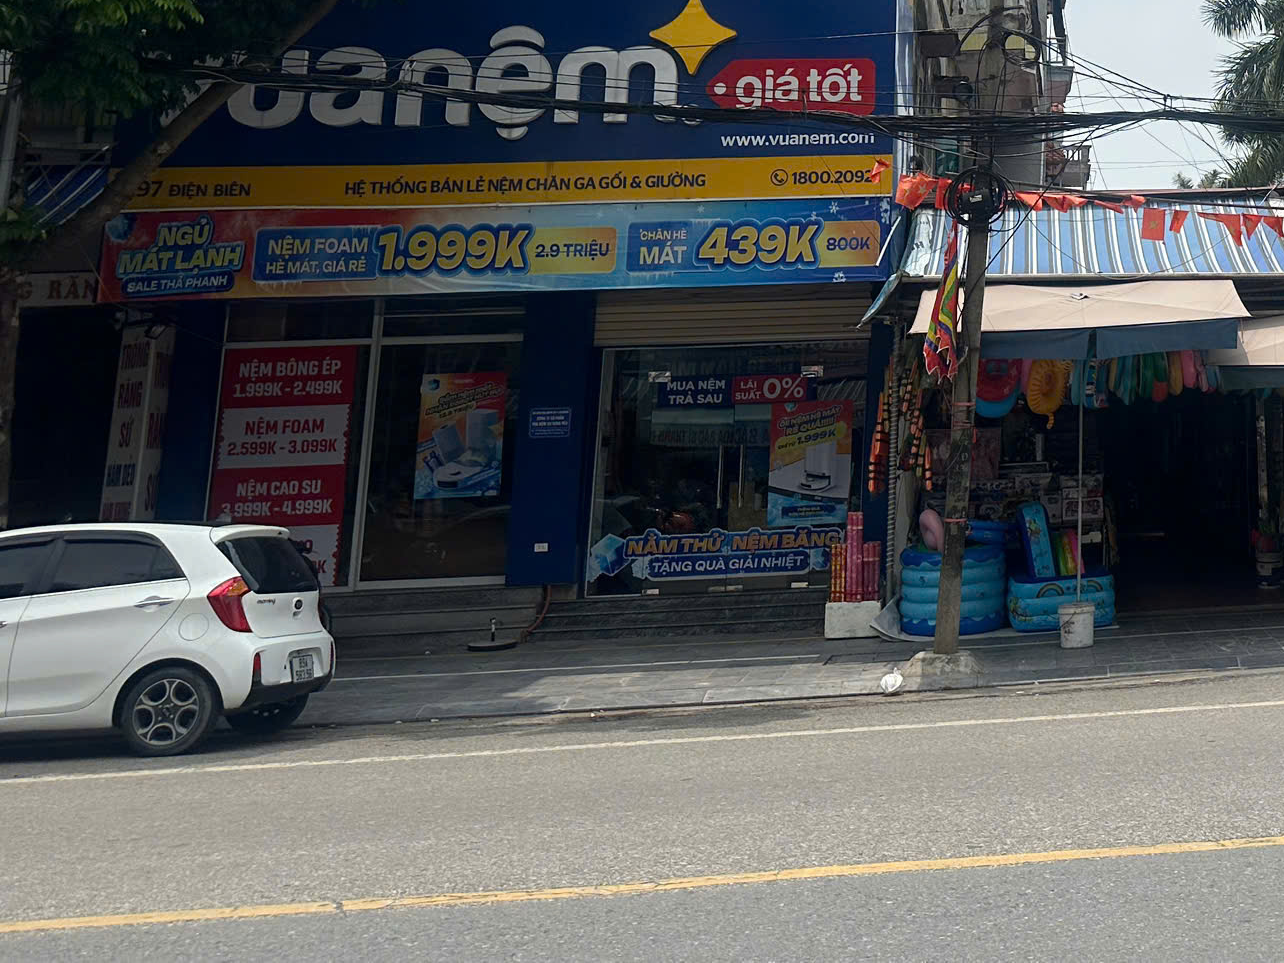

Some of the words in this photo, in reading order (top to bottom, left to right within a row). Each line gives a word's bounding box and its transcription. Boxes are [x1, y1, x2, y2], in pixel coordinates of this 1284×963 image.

[160, 25, 703, 141] uanệm
[735, 67, 799, 110] giá
[806, 63, 863, 103] tốt
[721, 131, 876, 148] www.vuanem.com
[169, 184, 208, 200] ĐIỆN
[213, 183, 252, 197] BIÊN
[344, 181, 364, 197] HỆ
[370, 176, 427, 194] THỐNG
[430, 177, 463, 193] BÁN
[467, 175, 485, 192] LẺ
[487, 175, 523, 195] NỆM
[525, 172, 570, 192] CHĂN
[573, 174, 598, 191] GA
[599, 170, 627, 190] GỐI
[630, 174, 642, 189] &
[644, 170, 706, 189] GIƯỜNG
[158, 219, 210, 246] NGỦ
[673, 228, 688, 240] HÈ
[267, 237, 310, 259] NỆM
[314, 236, 370, 254] FOAM
[378, 228, 529, 272] 1.999K
[562, 241, 611, 261] TRIỆU
[639, 241, 688, 265] MÁT
[699, 224, 818, 265] 439K
[826, 236, 870, 251] 800K
[120, 247, 169, 274] MÁT
[174, 245, 242, 275] LẠNH
[265, 258, 285, 275] HÈ
[287, 257, 320, 275] MÁT,
[322, 256, 347, 273] GIÁ
[348, 255, 366, 273] RẺ
[127, 279, 158, 293] SALE
[160, 276, 184, 290] THẢ
[185, 275, 228, 289] PHANH
[239, 359, 275, 381] NỆM
[276, 358, 319, 376] BÔNG
[322, 358, 341, 375] ÉP
[233, 381, 283, 398] 1.999K
[292, 380, 342, 396] 2.499K
[666, 381, 695, 391] MUA
[697, 379, 726, 392] NỆM
[735, 390, 761, 401] SUẤT
[762, 378, 804, 399] 0%
[668, 392, 694, 405] TRẢ
[697, 394, 723, 405] SAU
[245, 417, 278, 439] NỆM
[282, 418, 325, 435] FOAM
[228, 440, 276, 456] 2.599K
[288, 438, 337, 455] 3.099K
[236, 479, 269, 500] NỆM
[270, 480, 299, 496] CAO
[302, 480, 322, 495] SU
[282, 499, 333, 515] 4.999K
[680, 532, 724, 554] THỬ
[731, 531, 779, 555] NỆM
[780, 528, 842, 550] BĂNG
[651, 558, 692, 575] TẶNG
[695, 556, 725, 572] QUÀ
[729, 554, 758, 570] GIẢI
[760, 553, 805, 570] NHIỆT
